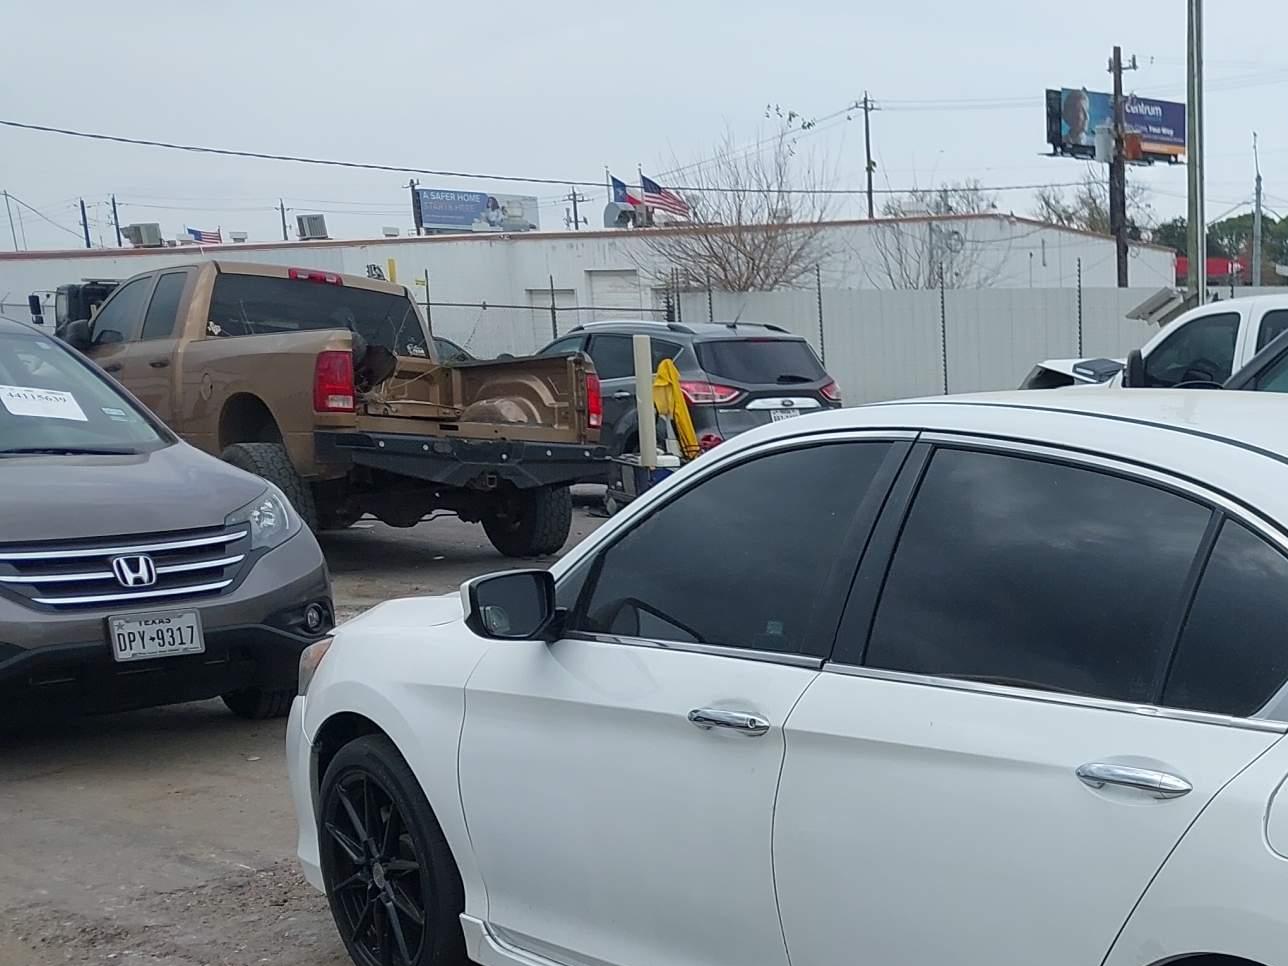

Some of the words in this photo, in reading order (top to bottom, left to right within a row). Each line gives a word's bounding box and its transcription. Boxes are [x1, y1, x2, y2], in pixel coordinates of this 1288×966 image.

[423, 191, 429, 199] A
[430, 191, 455, 201] SAFER
[456, 193, 480, 202] HOME
[138, 617, 172, 627] TEXAS
